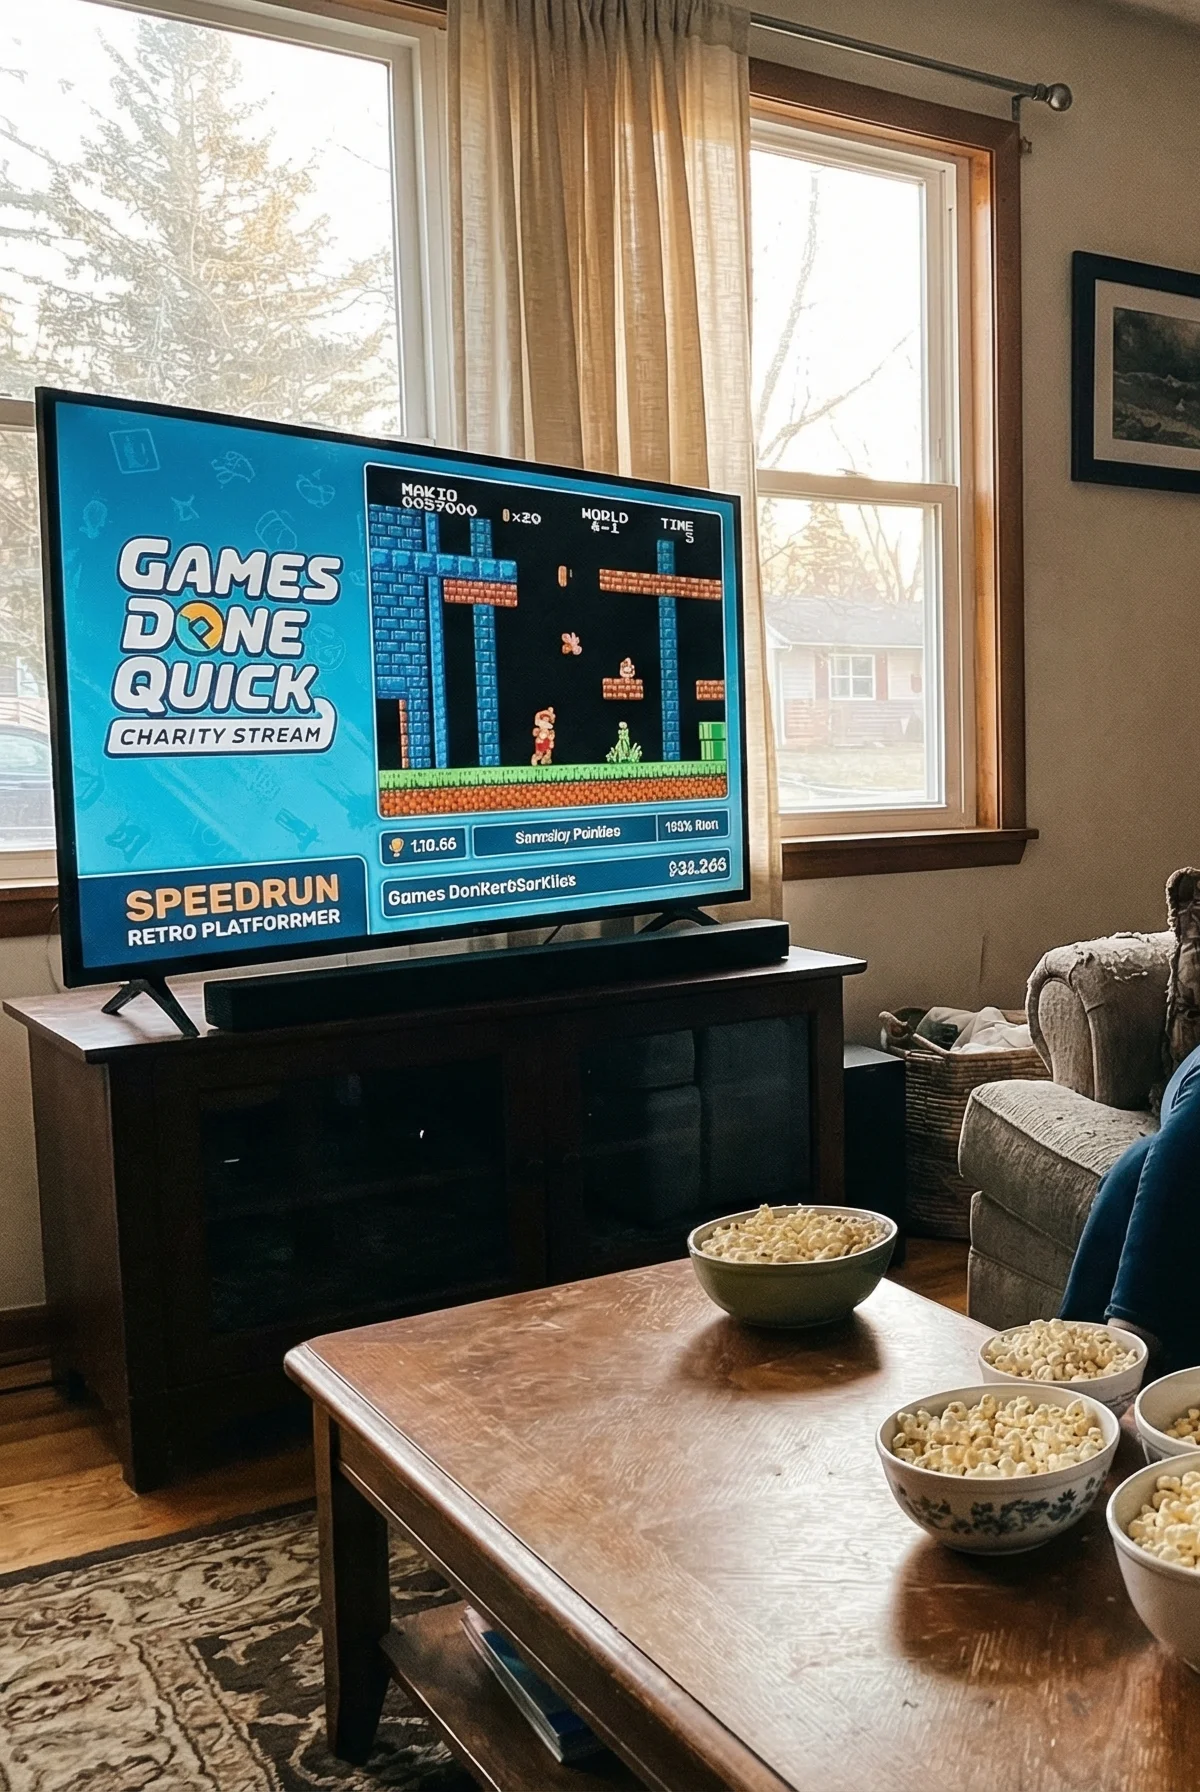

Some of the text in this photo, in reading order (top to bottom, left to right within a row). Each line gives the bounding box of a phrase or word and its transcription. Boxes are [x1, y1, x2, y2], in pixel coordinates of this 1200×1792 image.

[660, 517, 694, 532] TIME
[118, 536, 342, 602] GAMES
[120, 596, 309, 657] DONE
[112, 654, 318, 716] QUICK
[120, 727, 321, 745] CHARITY STREAM
[125, 873, 340, 922] SPEEDRUN
[388, 888, 446, 906] Games
[127, 908, 341, 946] RETRO PLATFORRMER
